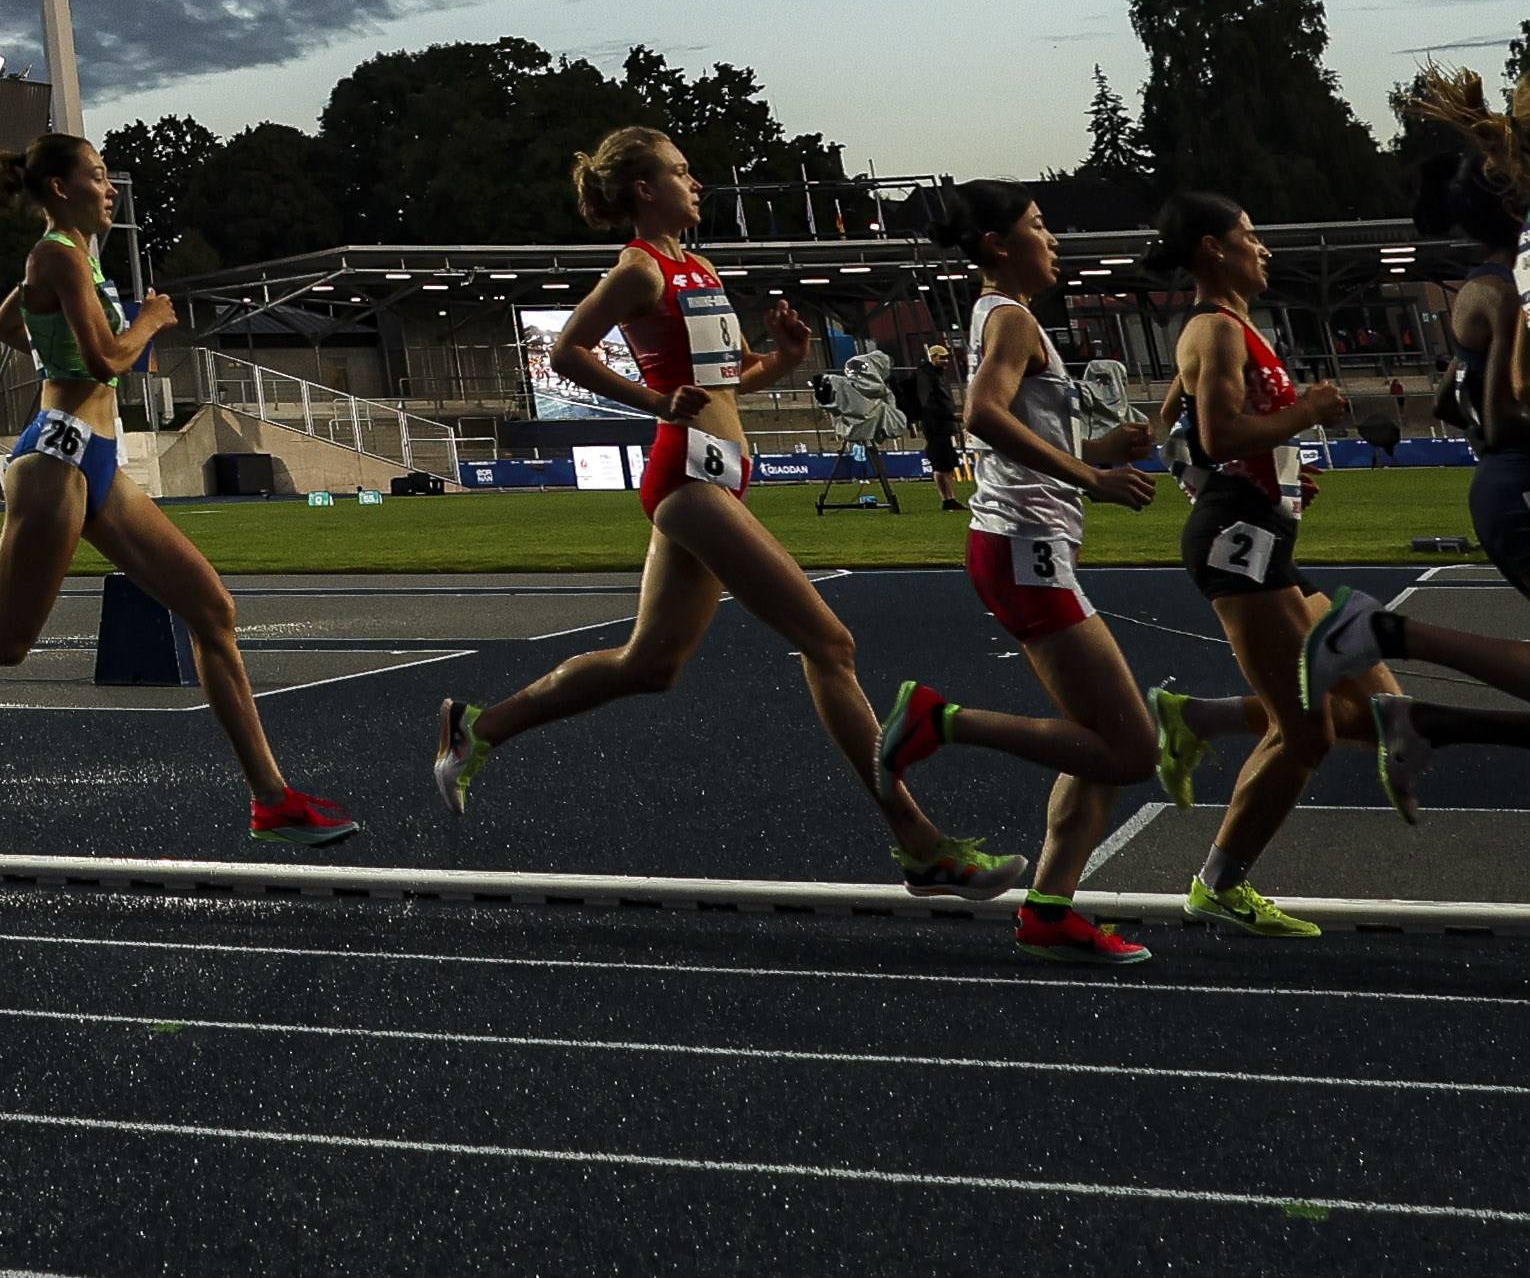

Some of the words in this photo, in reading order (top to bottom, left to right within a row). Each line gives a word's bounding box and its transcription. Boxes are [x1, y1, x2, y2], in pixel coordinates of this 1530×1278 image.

[720, 317, 731, 346] 8
[44, 420, 82, 456] 26
[704, 443, 724, 476] 8
[767, 466, 808, 474] QIAODAN
[1032, 541, 1054, 578] 3
[1229, 533, 1254, 567] 2
